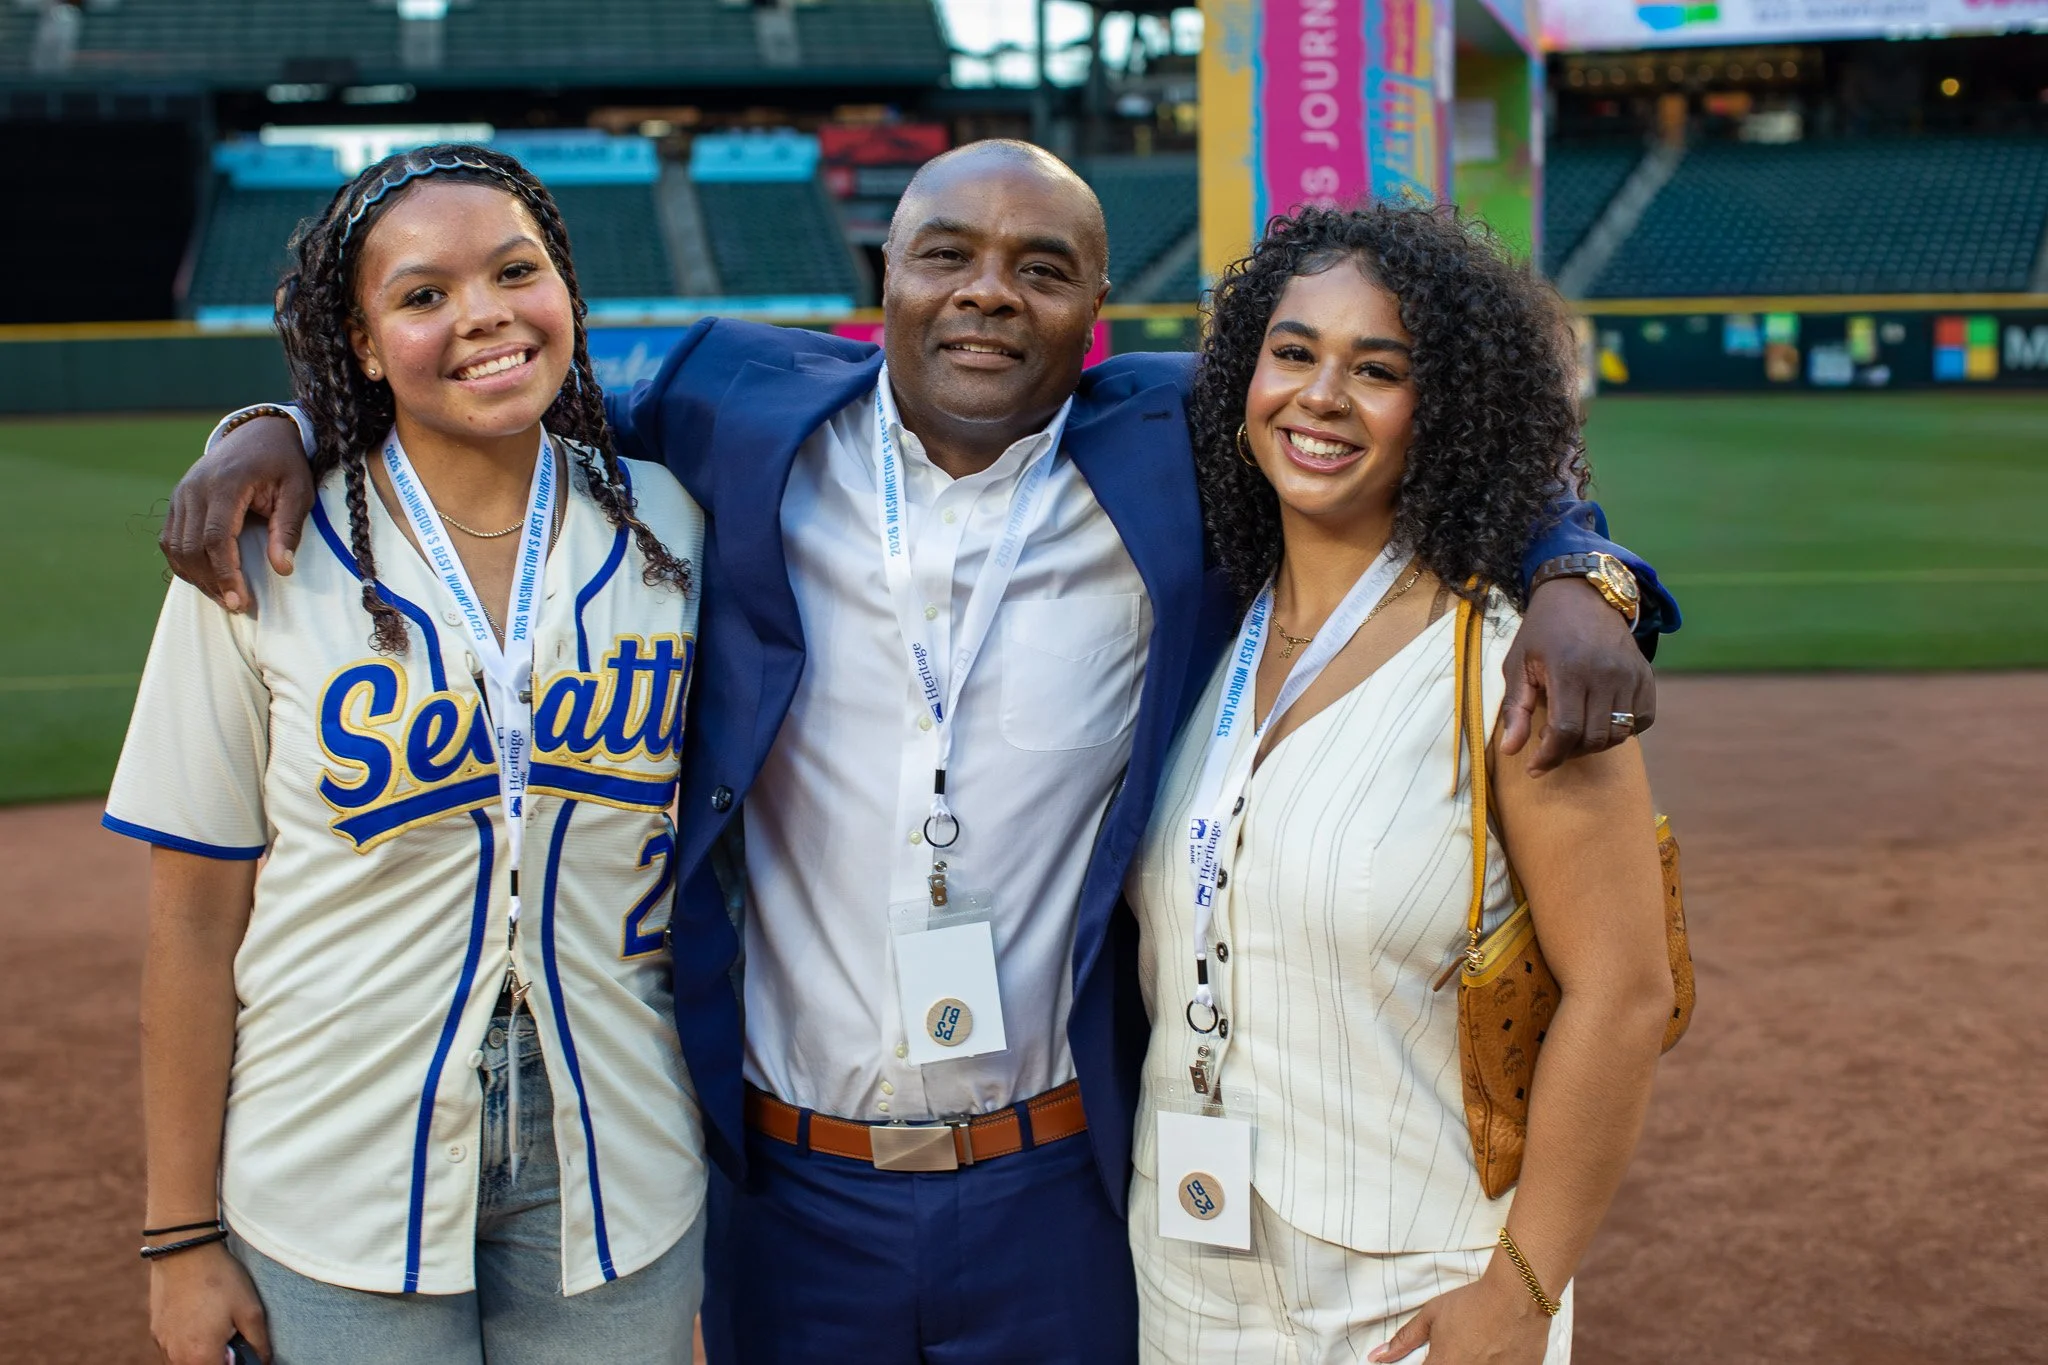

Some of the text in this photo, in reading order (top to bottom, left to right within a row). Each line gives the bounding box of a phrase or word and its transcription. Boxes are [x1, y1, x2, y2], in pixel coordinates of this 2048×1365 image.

[883, 444, 899, 524] WASHINGTON'S
[385, 444, 488, 641] 2026 WASHINGTON'S BEST WORKPLACES
[513, 444, 553, 641] 2026 WASHINGTON'S BEST WORKPLACES
[888, 526, 901, 557] 2026
[912, 642, 938, 700] Heritage
[1241, 639, 1257, 670] BEST
[1216, 667, 1249, 738] WORKPLACES
[508, 729, 525, 791] Heritage
[1200, 821, 1221, 879] Heritage
[620, 829, 675, 961] 2
